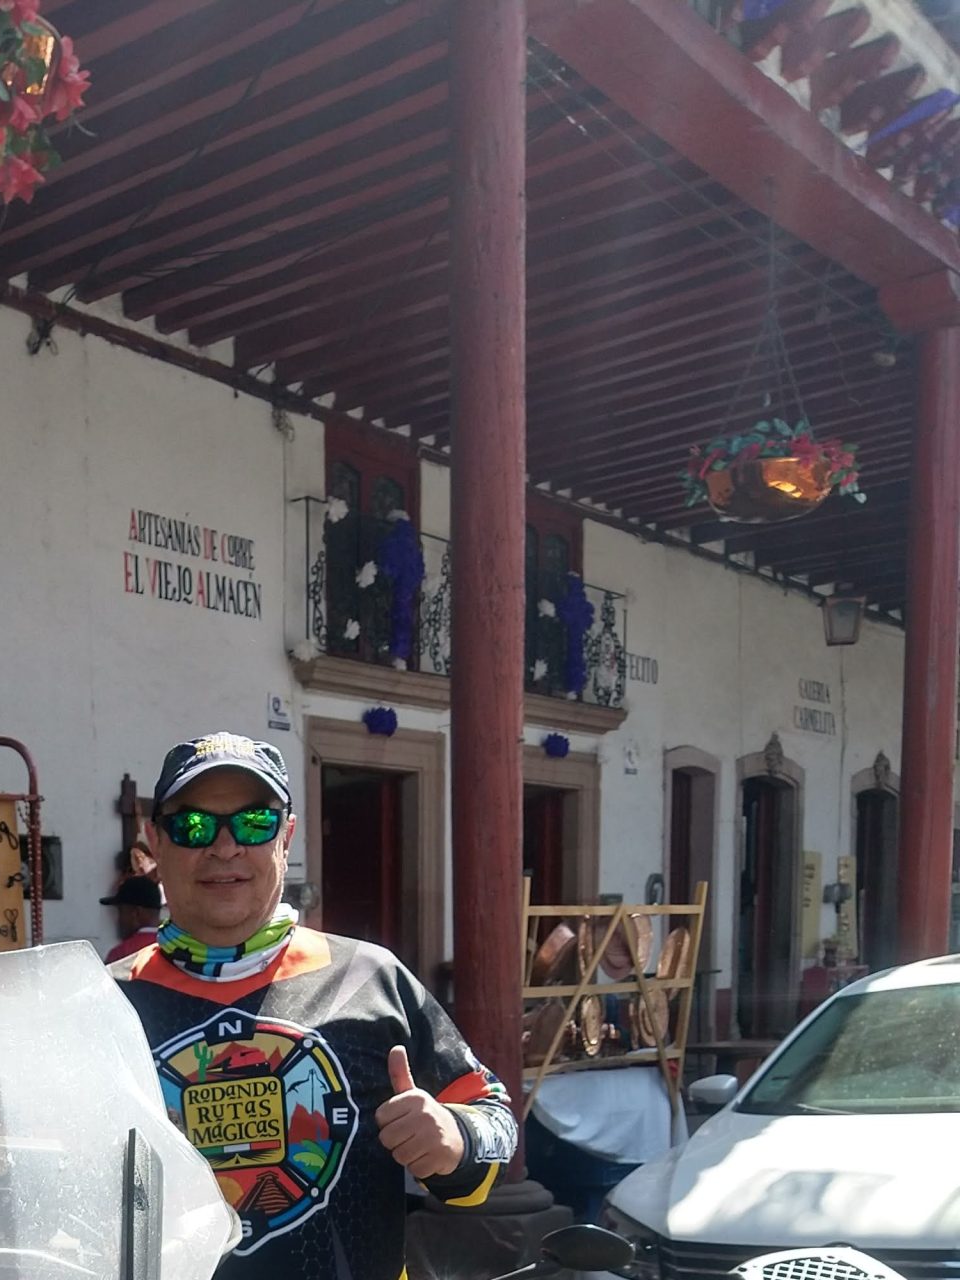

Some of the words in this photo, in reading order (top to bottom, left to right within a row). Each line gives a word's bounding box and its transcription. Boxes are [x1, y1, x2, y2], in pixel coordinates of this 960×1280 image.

[203, 527, 218, 562] DE
[123, 551, 144, 595] EL
[146, 557, 192, 604] VIEJO
[218, 1020, 242, 1037] N
[332, 1108, 348, 1125] E
